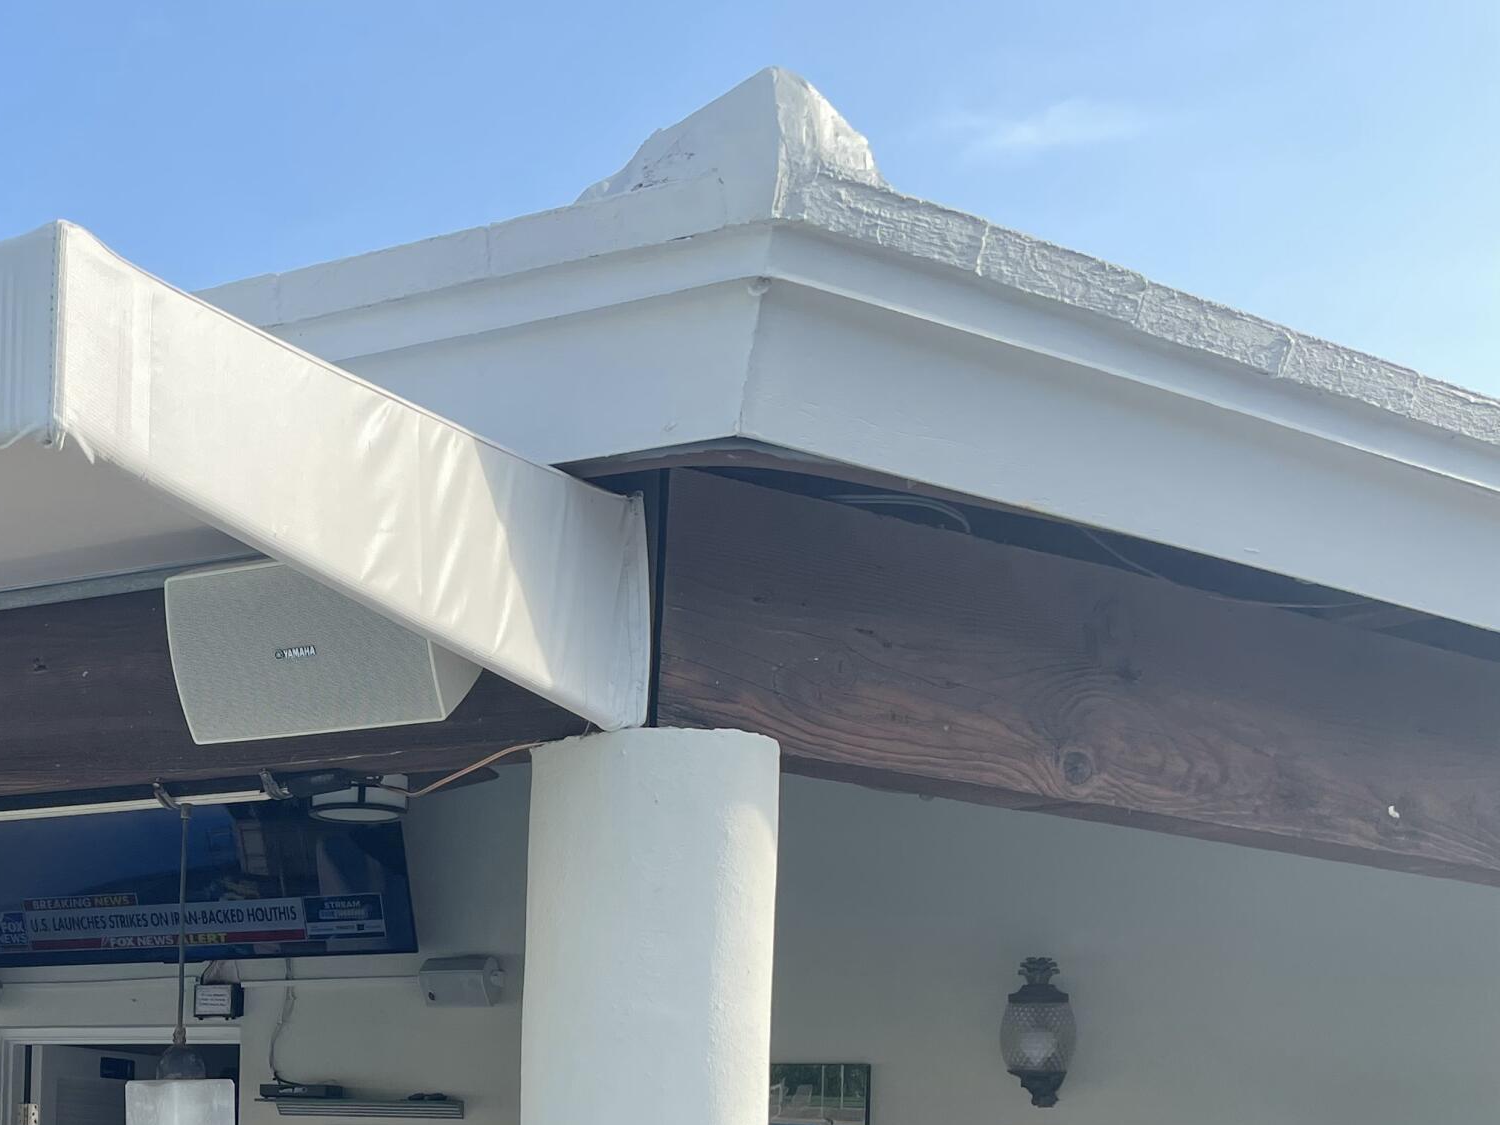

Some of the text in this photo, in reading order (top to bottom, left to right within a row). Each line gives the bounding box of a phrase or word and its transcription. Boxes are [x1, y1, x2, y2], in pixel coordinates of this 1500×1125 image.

[283, 646, 315, 658] YAMAHA
[32, 895, 130, 910] BREAKING NEWS
[30, 918, 51, 933] U.S.
[52, 914, 107, 932] LAUNCHES
[108, 912, 149, 929] STRIKES
[150, 911, 169, 927] ON
[246, 905, 298, 923] HOUTHIS
[1, 921, 26, 934] FOX
[109, 936, 134, 948] FOX
[136, 935, 174, 946] NEWS
